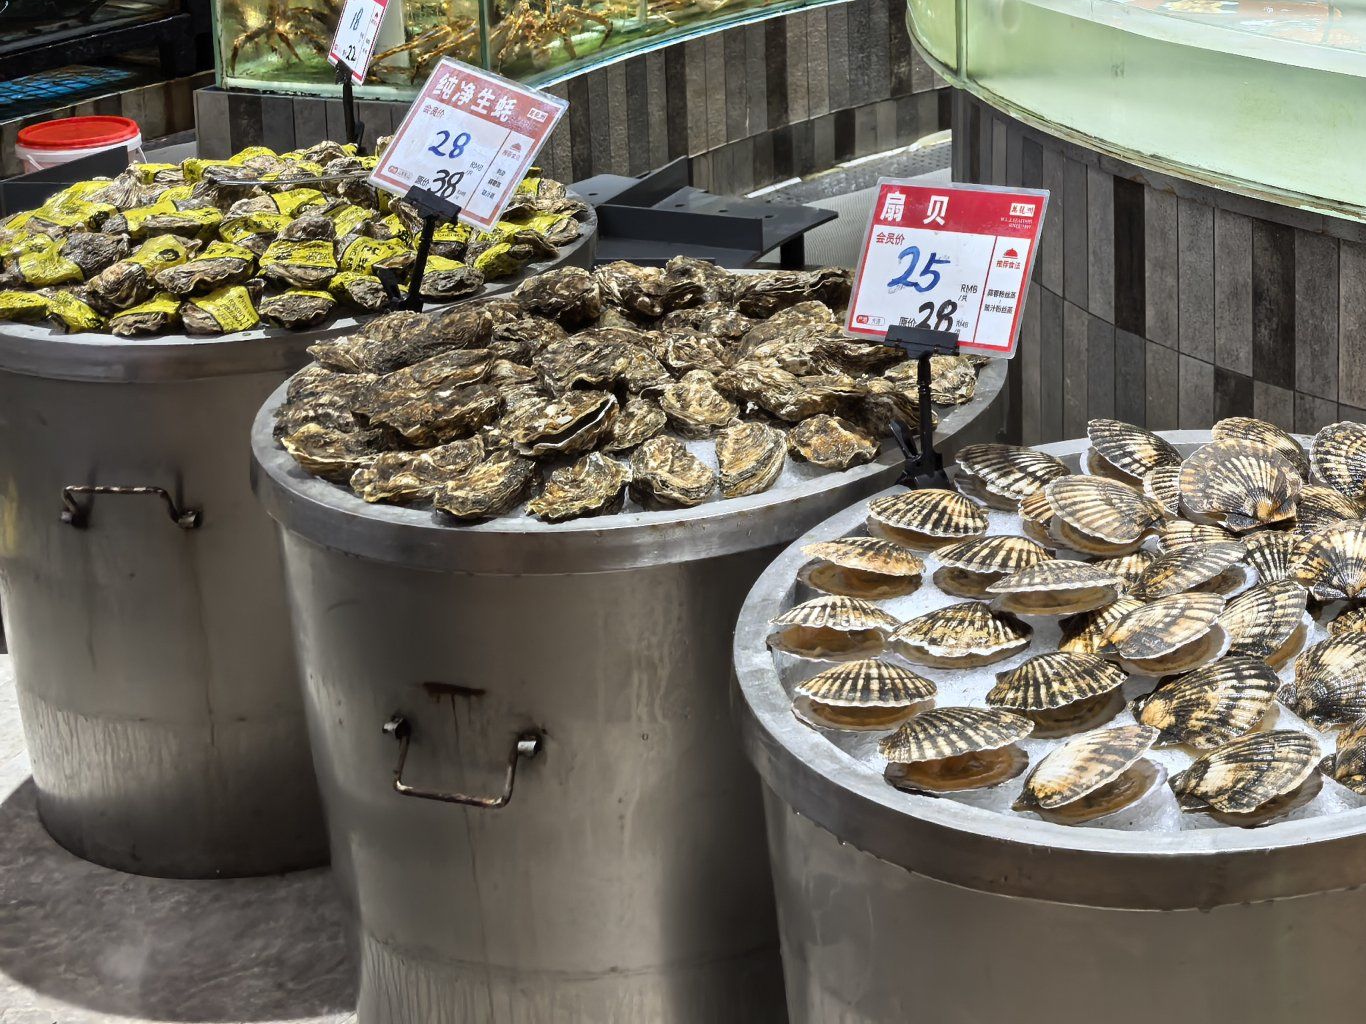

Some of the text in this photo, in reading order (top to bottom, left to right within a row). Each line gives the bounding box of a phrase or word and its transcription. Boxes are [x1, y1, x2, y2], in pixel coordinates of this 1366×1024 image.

[422, 104, 446, 119] 会员价
[432, 72, 518, 123] 纯净生蚝
[428, 130, 472, 159] 28
[429, 169, 465, 198] 38
[880, 191, 950, 226] 扇贝
[875, 232, 905, 245] 会员价
[886, 245, 951, 293] 25
[996, 260, 1021, 270] 推荐食法
[960, 283, 978, 293] RMB
[918, 299, 958, 331] 28
